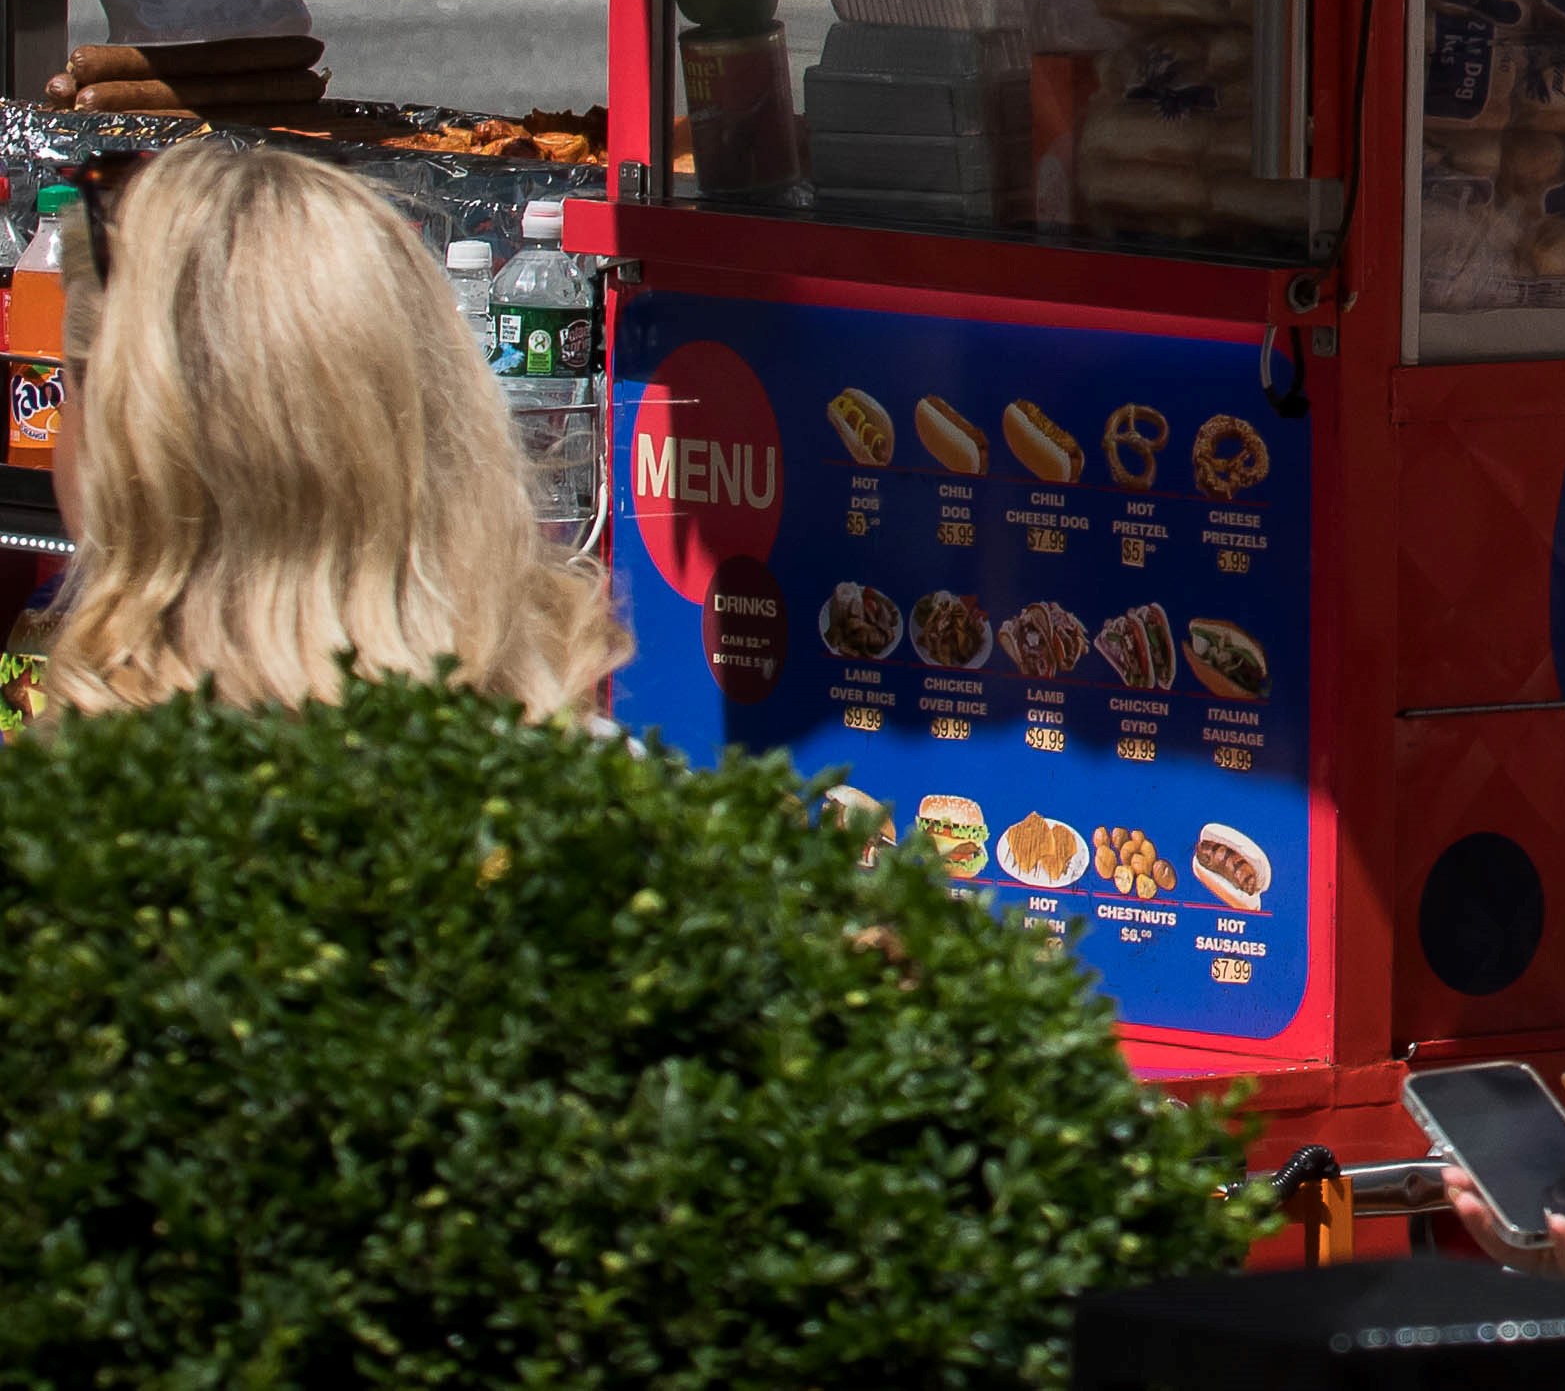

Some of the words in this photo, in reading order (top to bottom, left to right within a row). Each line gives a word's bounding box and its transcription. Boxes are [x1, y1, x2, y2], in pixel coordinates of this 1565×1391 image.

[637, 433, 776, 510] MENU
[852, 475, 880, 491] HOT
[939, 484, 973, 499] CHILI
[851, 497, 880, 511] DOG
[1031, 492, 1065, 507] CHILI
[942, 505, 971, 520] DOG
[1127, 501, 1155, 517] HOT
[1006, 510, 1057, 527] CHEESE
[1060, 515, 1090, 530] DOG
[1209, 510, 1261, 528] CHEESE
[937, 522, 976, 546] $5.99
[1112, 520, 1168, 538] PRETZEL
[1028, 528, 1066, 552] $7.99
[1203, 530, 1267, 549] PRETZELS
[714, 594, 777, 617] DRINKS
[721, 634, 744, 647] CAN
[713, 652, 752, 668] BOTTLE
[845, 668, 881, 684] LAMB
[924, 677, 982, 695] CHICKEN
[830, 686, 863, 702] OVER
[867, 691, 896, 707] RICE
[1027, 688, 1064, 705] LAMB
[919, 697, 954, 713] OVER
[957, 700, 988, 716] RICE
[1110, 698, 1169, 716] CHICKEN
[844, 708, 882, 729] $9.99
[1028, 709, 1064, 725] GYRO
[1208, 708, 1259, 726] ITALIAN
[931, 717, 971, 739] $9.99
[1121, 719, 1157, 736] GYRO
[1026, 727, 1066, 751] $9.99
[1203, 727, 1265, 748] SAUSAGE
[1118, 737, 1157, 761] $9.99
[1214, 746, 1253, 770] $9.99
[1029, 896, 1058, 913] HOT
[1097, 904, 1177, 927] CHESTNUTS
[1217, 918, 1247, 935] HOT
[1195, 936, 1267, 957] SAUSAGES
[1212, 960, 1252, 982] $7.99
